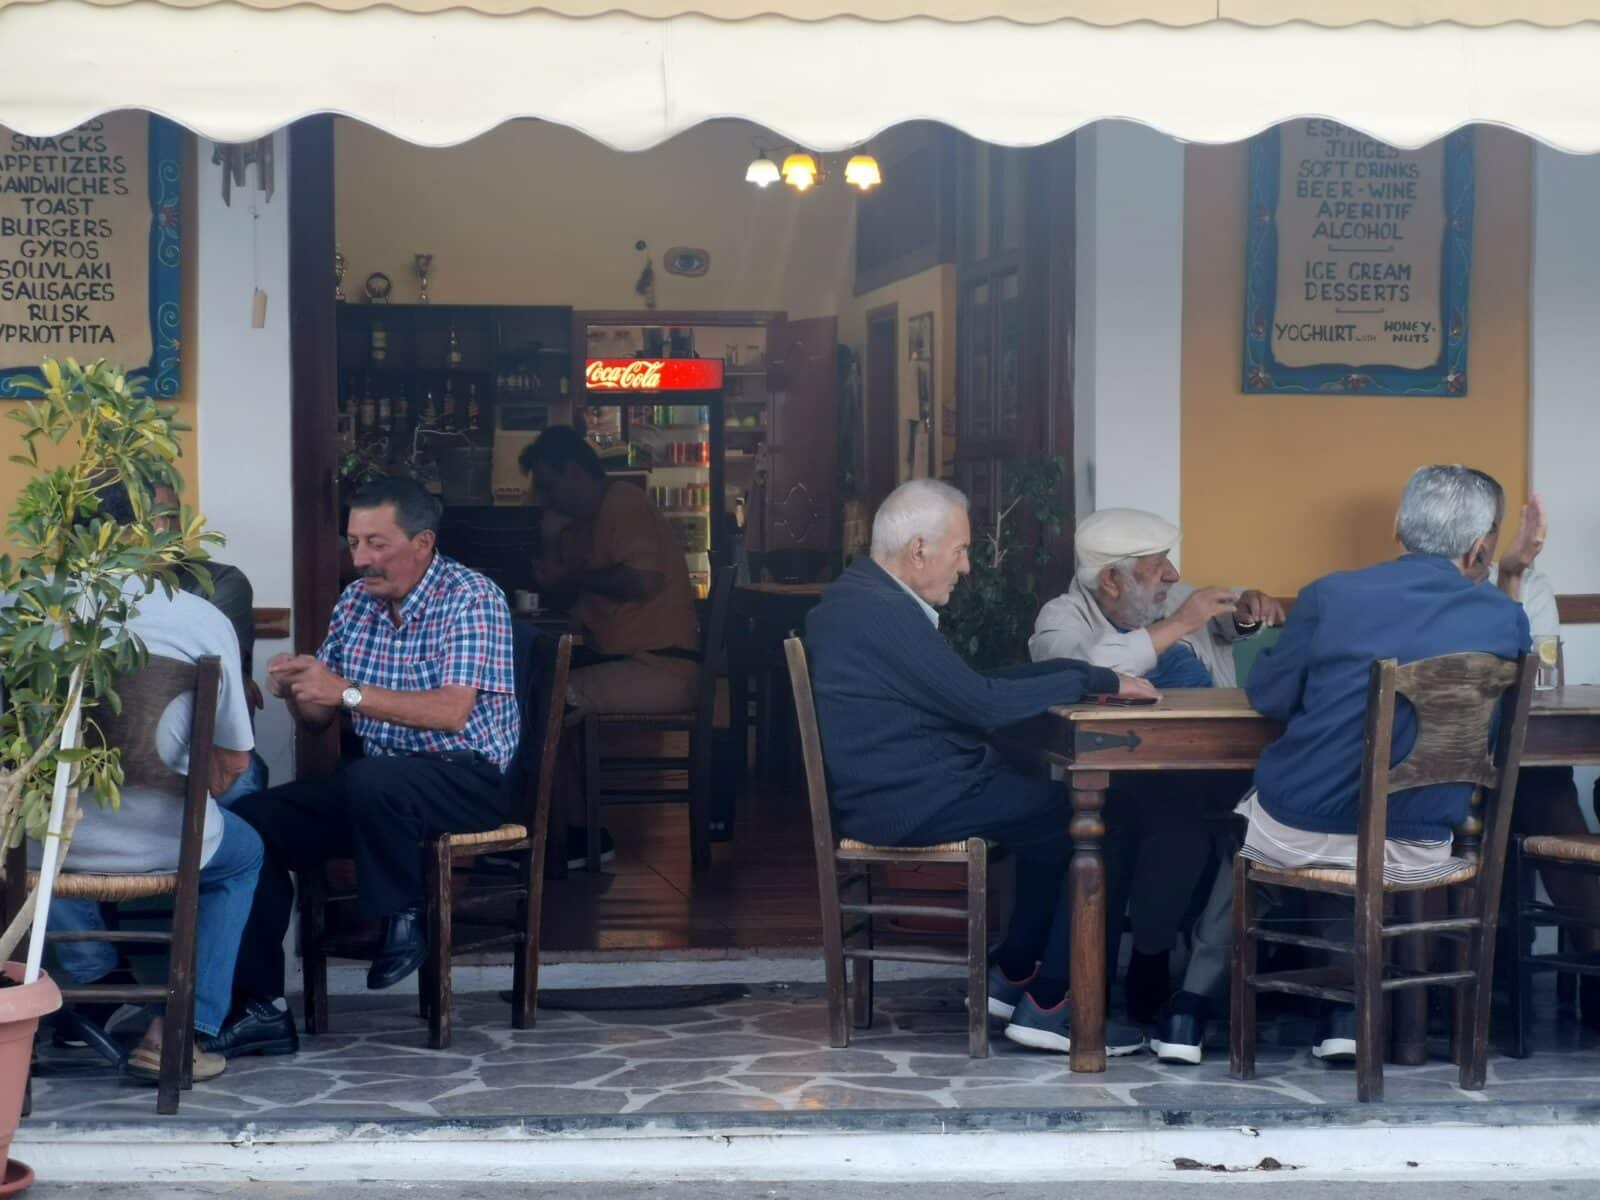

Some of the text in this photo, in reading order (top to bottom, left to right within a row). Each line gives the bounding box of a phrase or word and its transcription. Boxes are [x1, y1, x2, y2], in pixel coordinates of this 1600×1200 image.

[11, 133, 106, 153] SNACKS
[1298, 159, 1419, 179] SOFT DRINKS
[1296, 180, 1353, 198] BEER
[1368, 181, 1417, 199] WINE
[20, 197, 95, 216] TOAST
[1316, 200, 1412, 220] APERITIF
[2, 217, 112, 238] BURGERS
[1312, 221, 1404, 240] ALCOHOL
[20, 239, 99, 259] GYROS
[0, 259, 111, 279] SOUVLAKI
[1305, 261, 1412, 281] ICE CREAM
[1, 281, 115, 301] SAUSAGES
[1304, 282, 1410, 302] DESSERTS
[28, 303, 91, 322] RUSK
[68, 325, 115, 344] PITA
[1275, 323, 1356, 342] YOGHURT
[1392, 333, 1429, 343] NUTS
